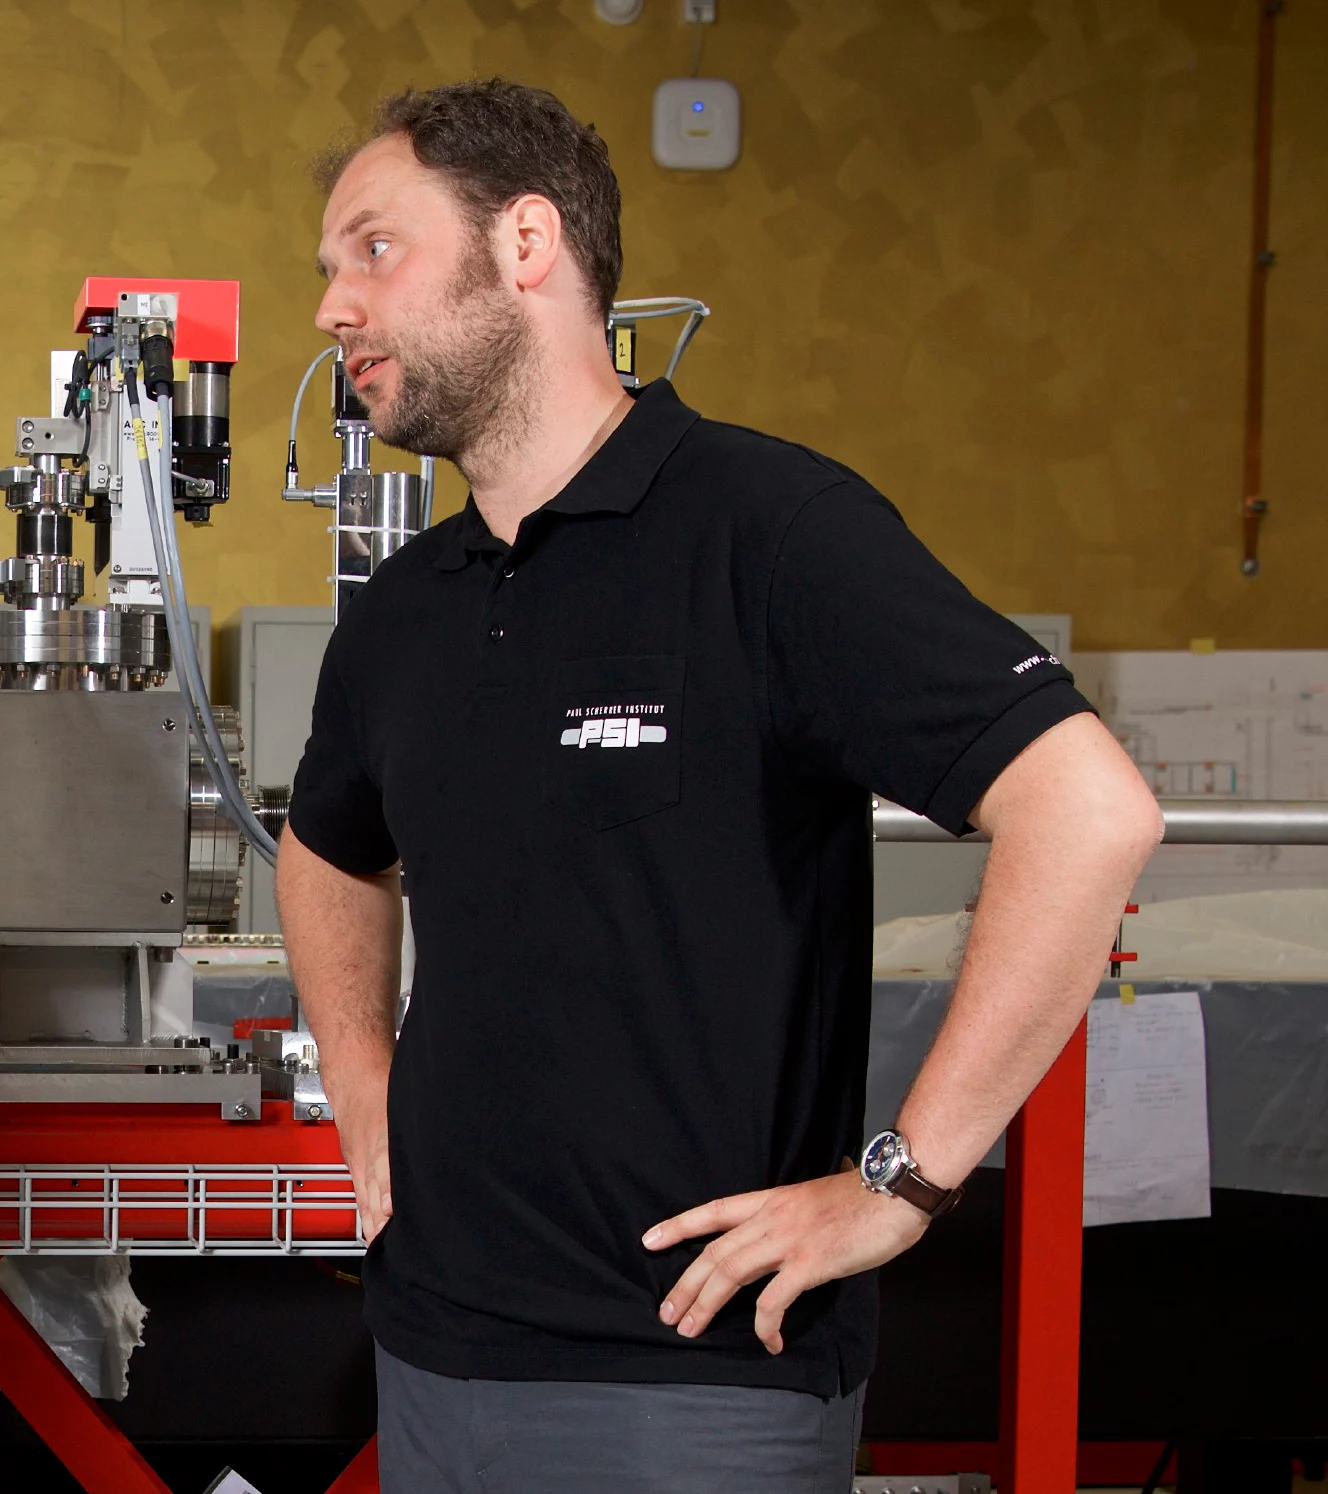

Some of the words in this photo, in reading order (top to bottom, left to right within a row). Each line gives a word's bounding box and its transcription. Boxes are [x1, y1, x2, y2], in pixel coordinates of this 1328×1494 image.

[566, 708, 583, 718] PAUL
[586, 705, 622, 716] SCHERRER
[625, 704, 665, 714] INSTITUT
[578, 717, 641, 749] PSI
